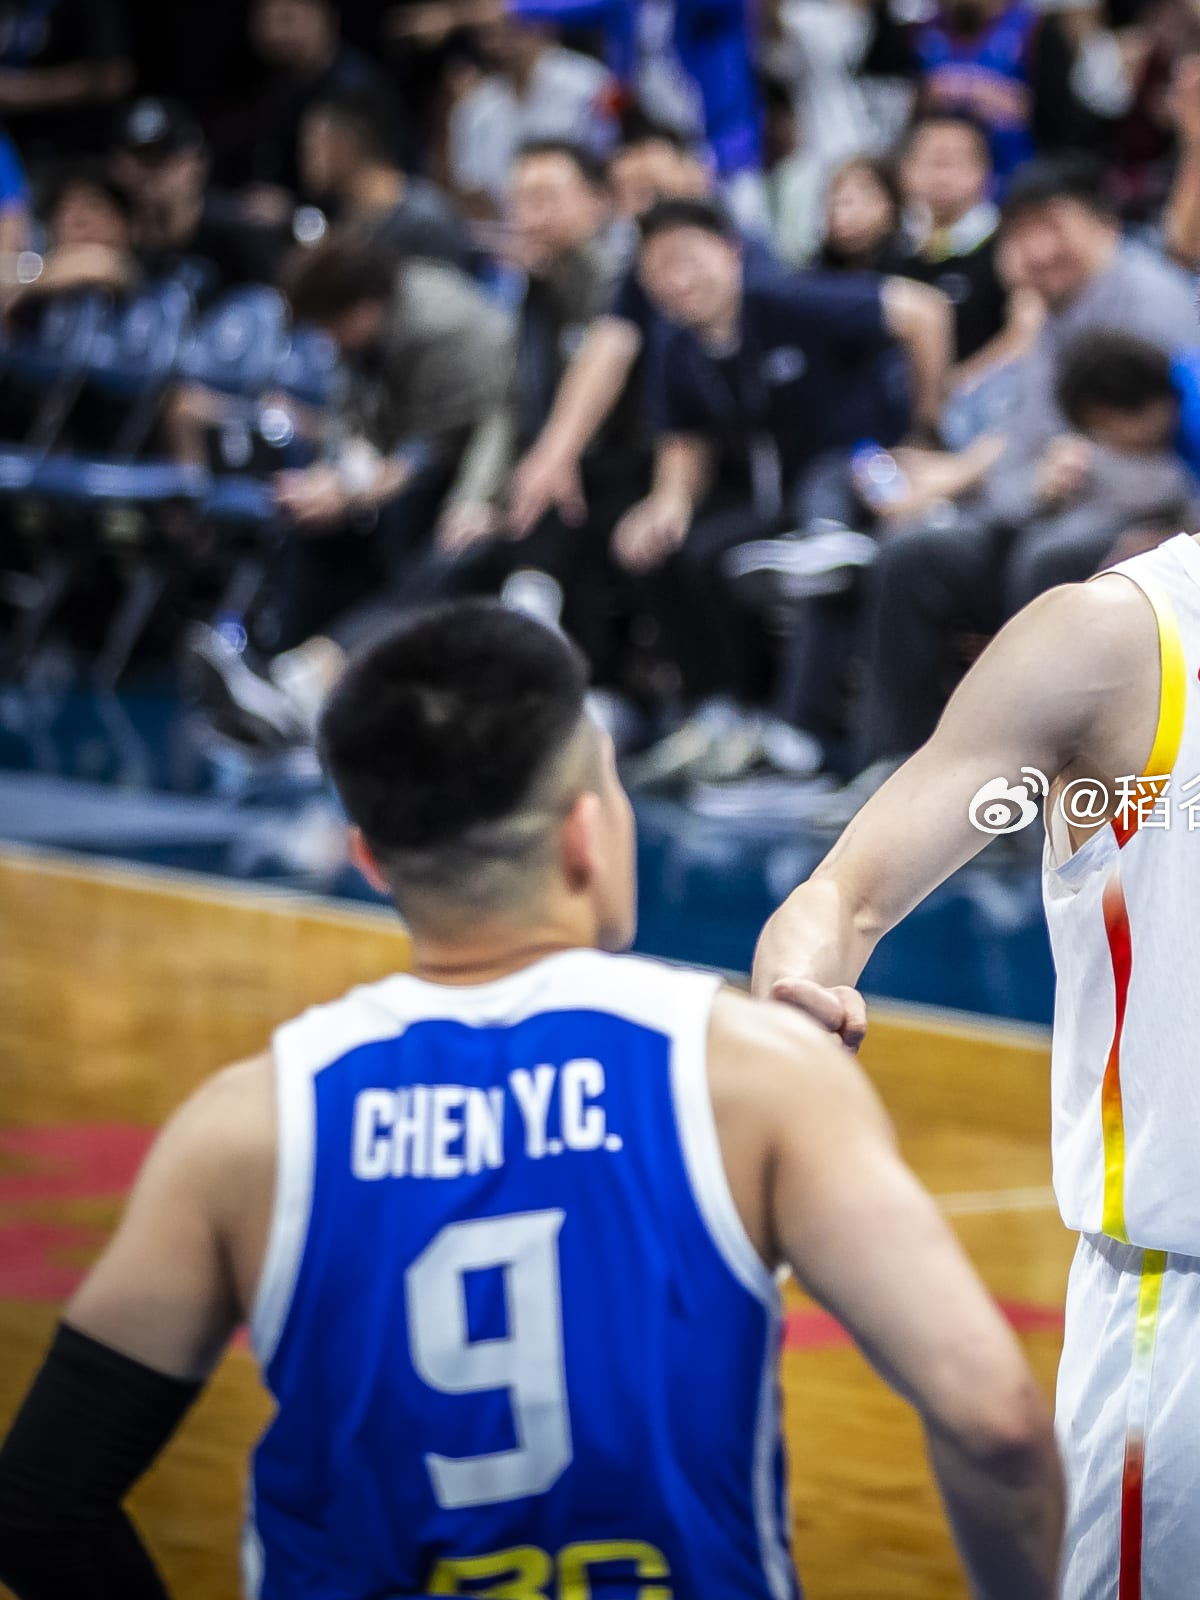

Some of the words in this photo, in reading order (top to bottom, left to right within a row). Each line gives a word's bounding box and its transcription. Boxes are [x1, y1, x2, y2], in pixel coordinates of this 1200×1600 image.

[351, 1083, 505, 1182] CHEN
[509, 1058, 624, 1160] Y.C.
[405, 1207, 574, 1510] 9
